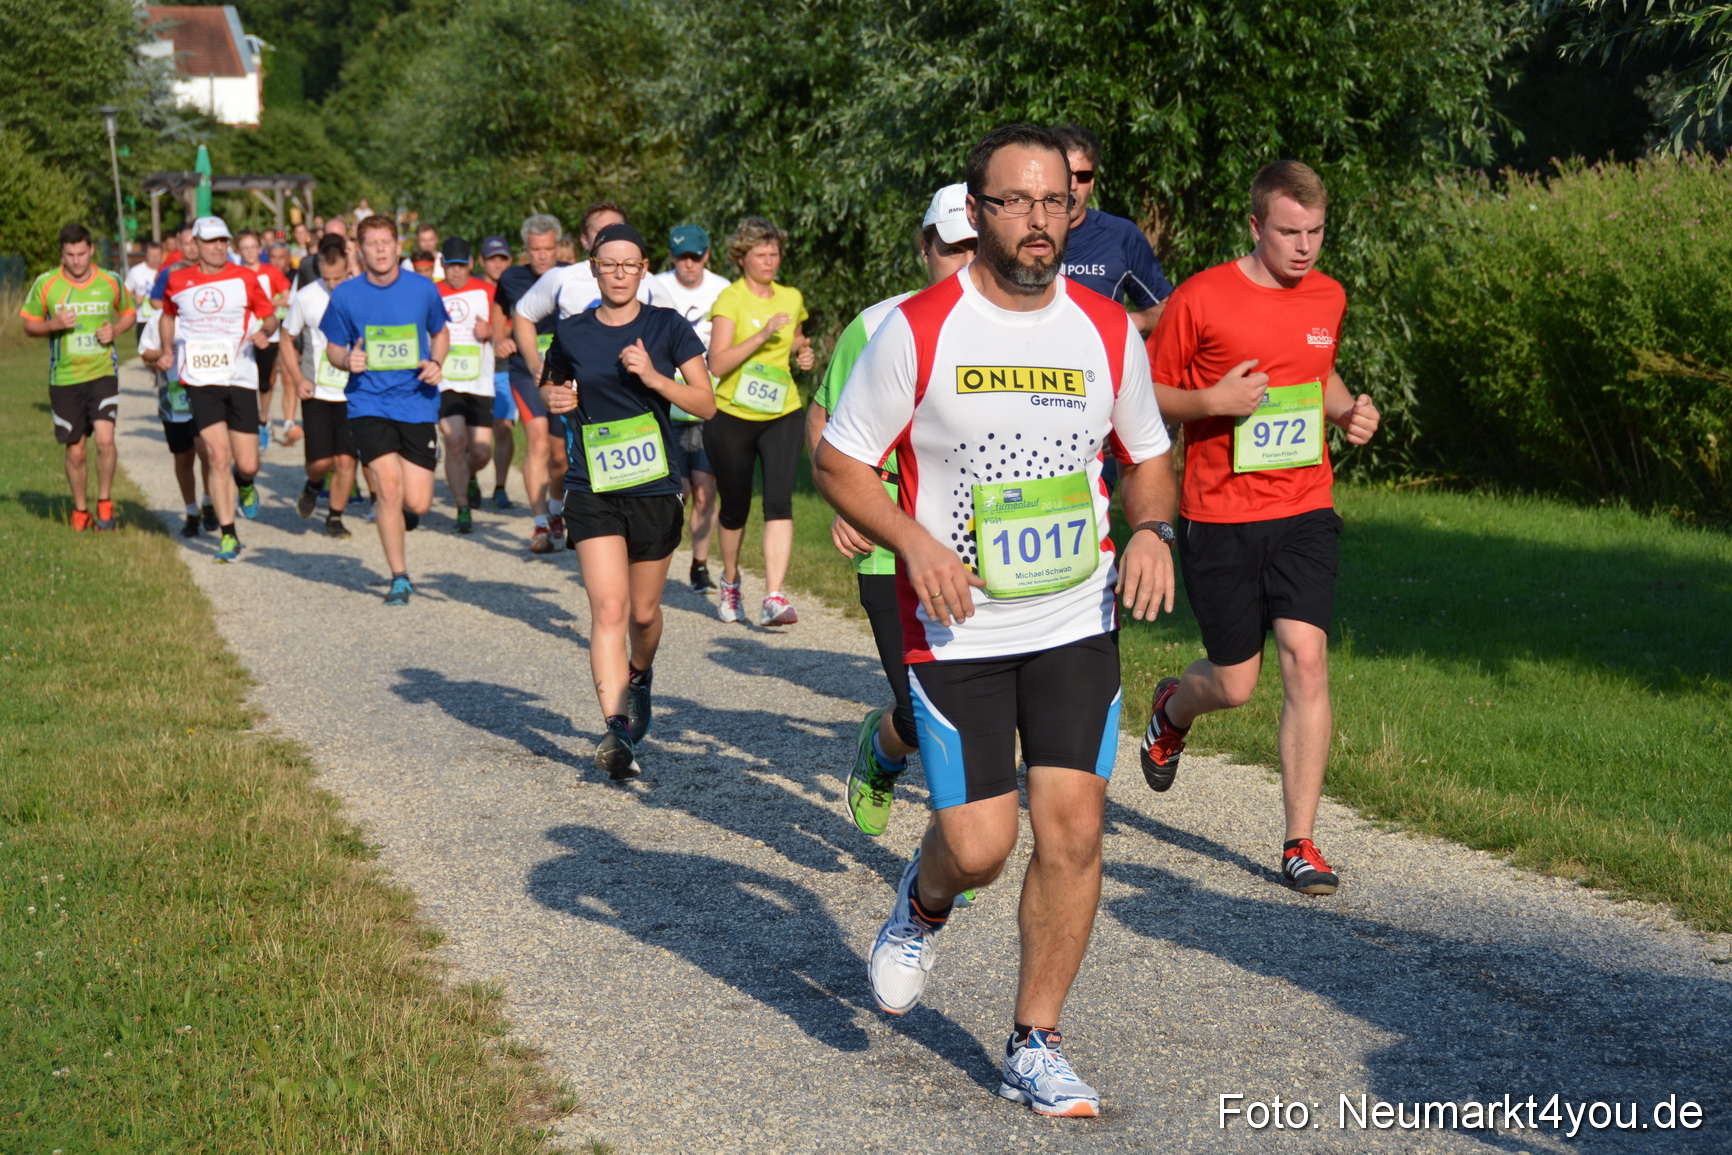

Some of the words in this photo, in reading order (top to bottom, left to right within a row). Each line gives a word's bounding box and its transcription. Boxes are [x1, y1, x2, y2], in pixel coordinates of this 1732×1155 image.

[1067, 264, 1106, 276] POLES
[377, 343, 409, 358] 736
[192, 353, 229, 369] 8924
[452, 358, 469, 371] 76
[963, 369, 1076, 392] ONLINE
[747, 380, 779, 403] 654
[1030, 394, 1087, 412] Germany
[1253, 418, 1306, 448] 972
[595, 441, 657, 472] 1300
[995, 498, 1040, 511] firmenlauf
[992, 518, 1087, 565] 1017
[1015, 570, 1044, 580] Michael
[1045, 565, 1072, 576] Schwab
